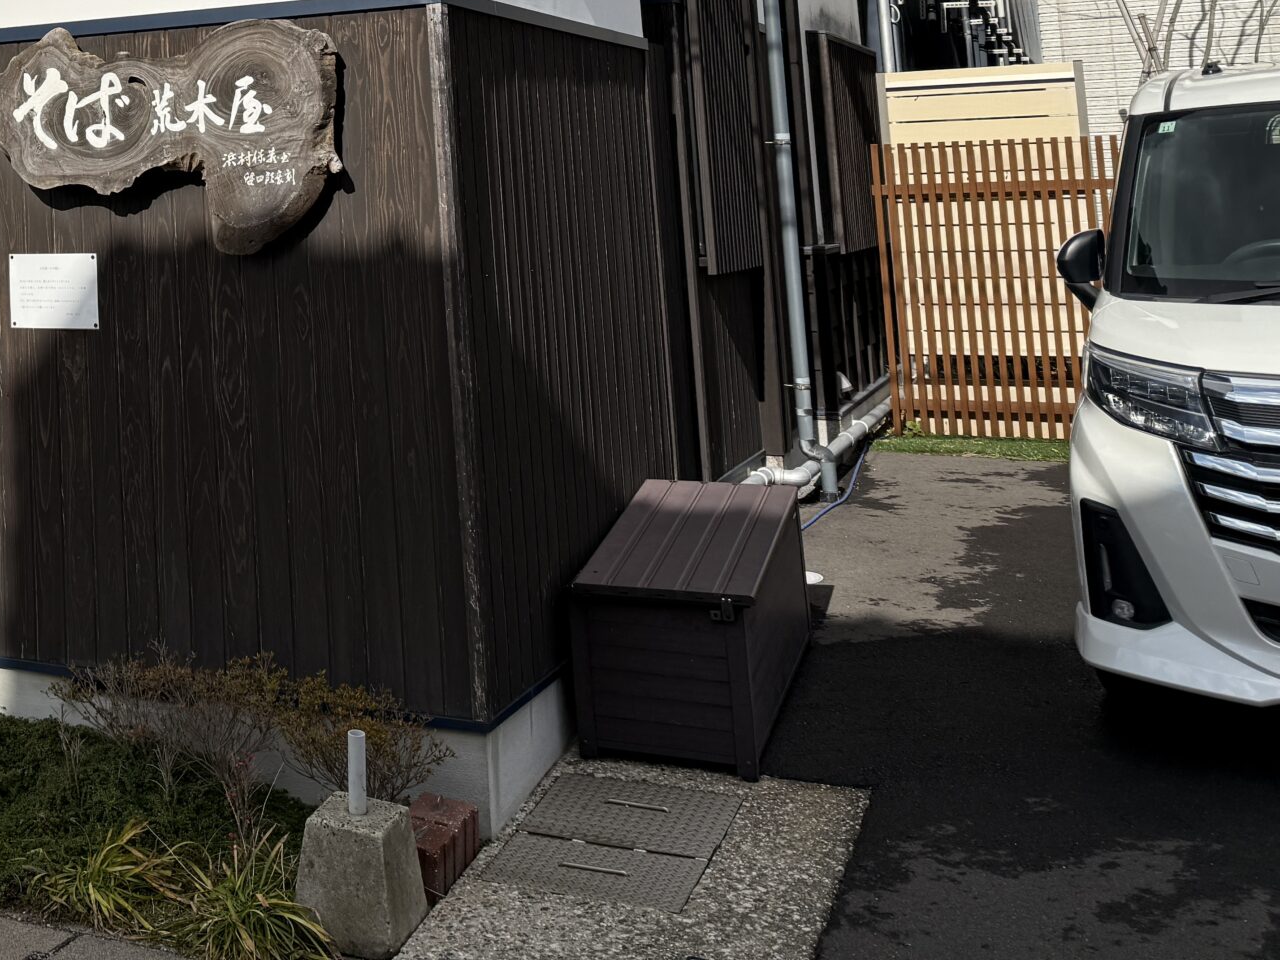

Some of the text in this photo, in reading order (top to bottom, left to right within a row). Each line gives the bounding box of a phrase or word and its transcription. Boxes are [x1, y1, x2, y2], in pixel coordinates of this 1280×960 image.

[12, 67, 273, 150] そば 荒木屋
